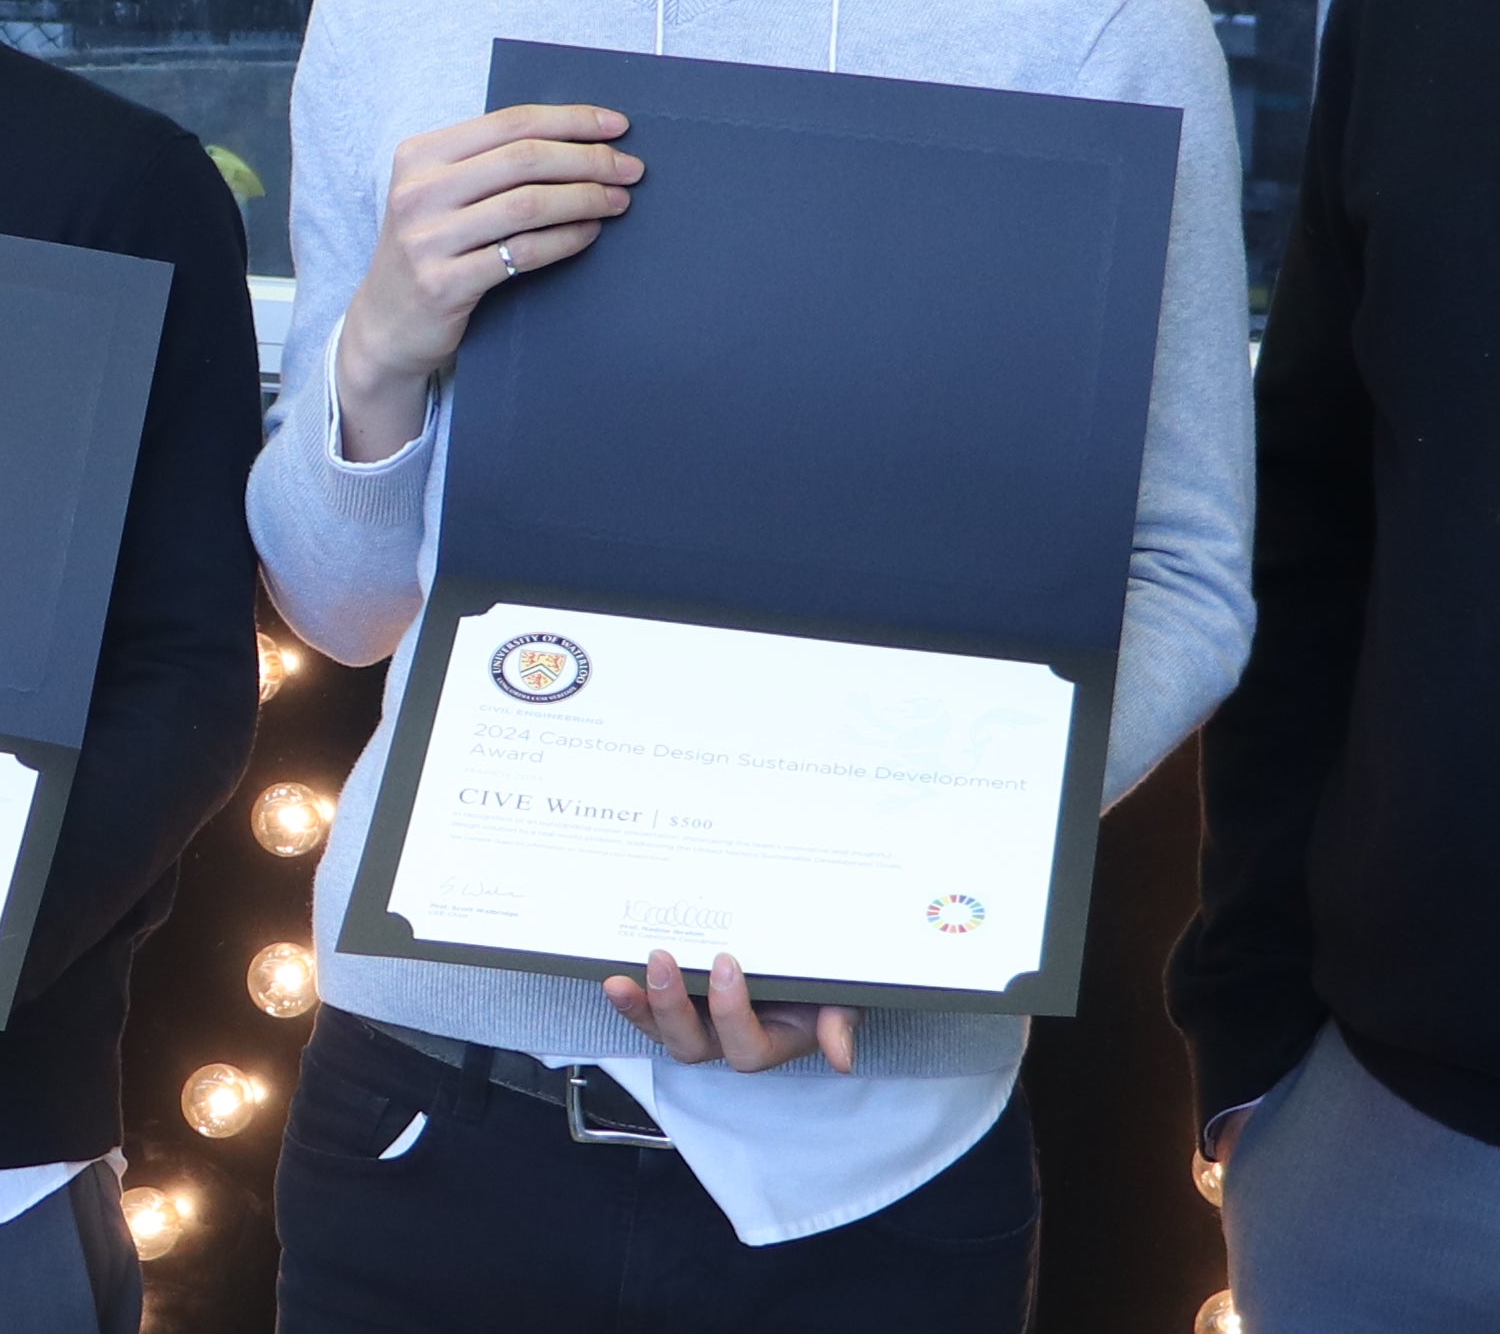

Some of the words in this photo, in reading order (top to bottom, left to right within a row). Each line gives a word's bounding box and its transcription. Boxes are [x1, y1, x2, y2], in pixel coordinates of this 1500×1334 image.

[492, 634, 539, 674] UNIVERSITY
[542, 634, 559, 643] OF
[560, 639, 588, 684] WATERLOO
[469, 741, 545, 764] Award
[472, 722, 531, 743] 2024
[538, 730, 646, 757] Capstone
[653, 744, 730, 766] Design
[737, 752, 867, 779] Sustainable
[874, 766, 1028, 792] Development
[458, 787, 535, 812] CIVE
[545, 796, 643, 824] Winner
[668, 815, 713, 831] $500
